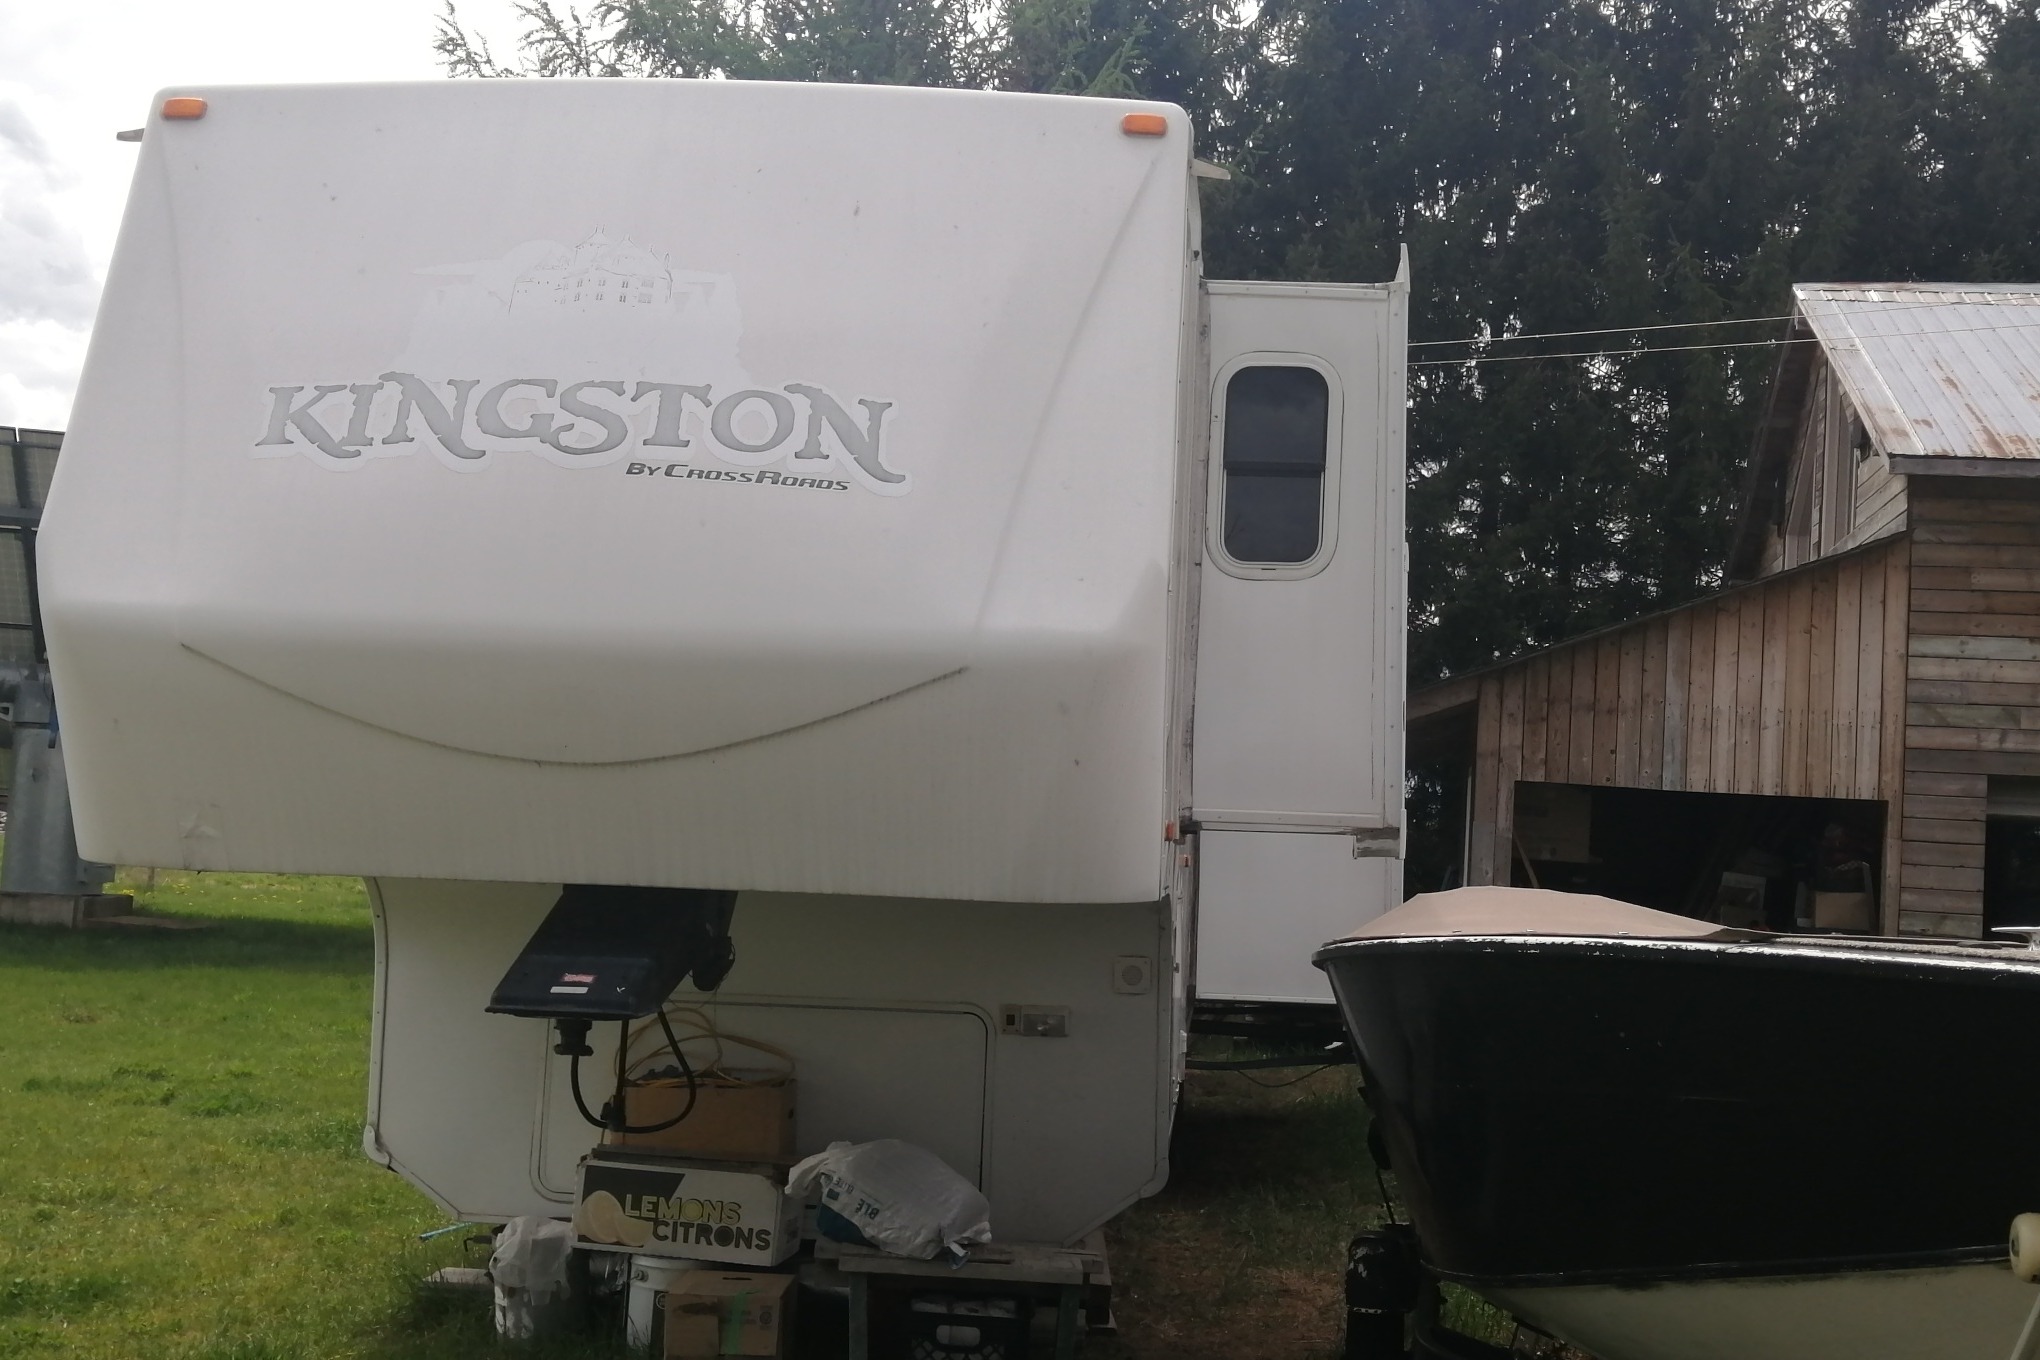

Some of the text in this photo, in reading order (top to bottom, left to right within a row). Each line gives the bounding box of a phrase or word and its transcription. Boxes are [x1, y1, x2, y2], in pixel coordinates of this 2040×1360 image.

[254, 371, 906, 484] KINGSTON
[624, 1193, 742, 1226] LEMONS
[652, 1220, 771, 1250] CITRONS
